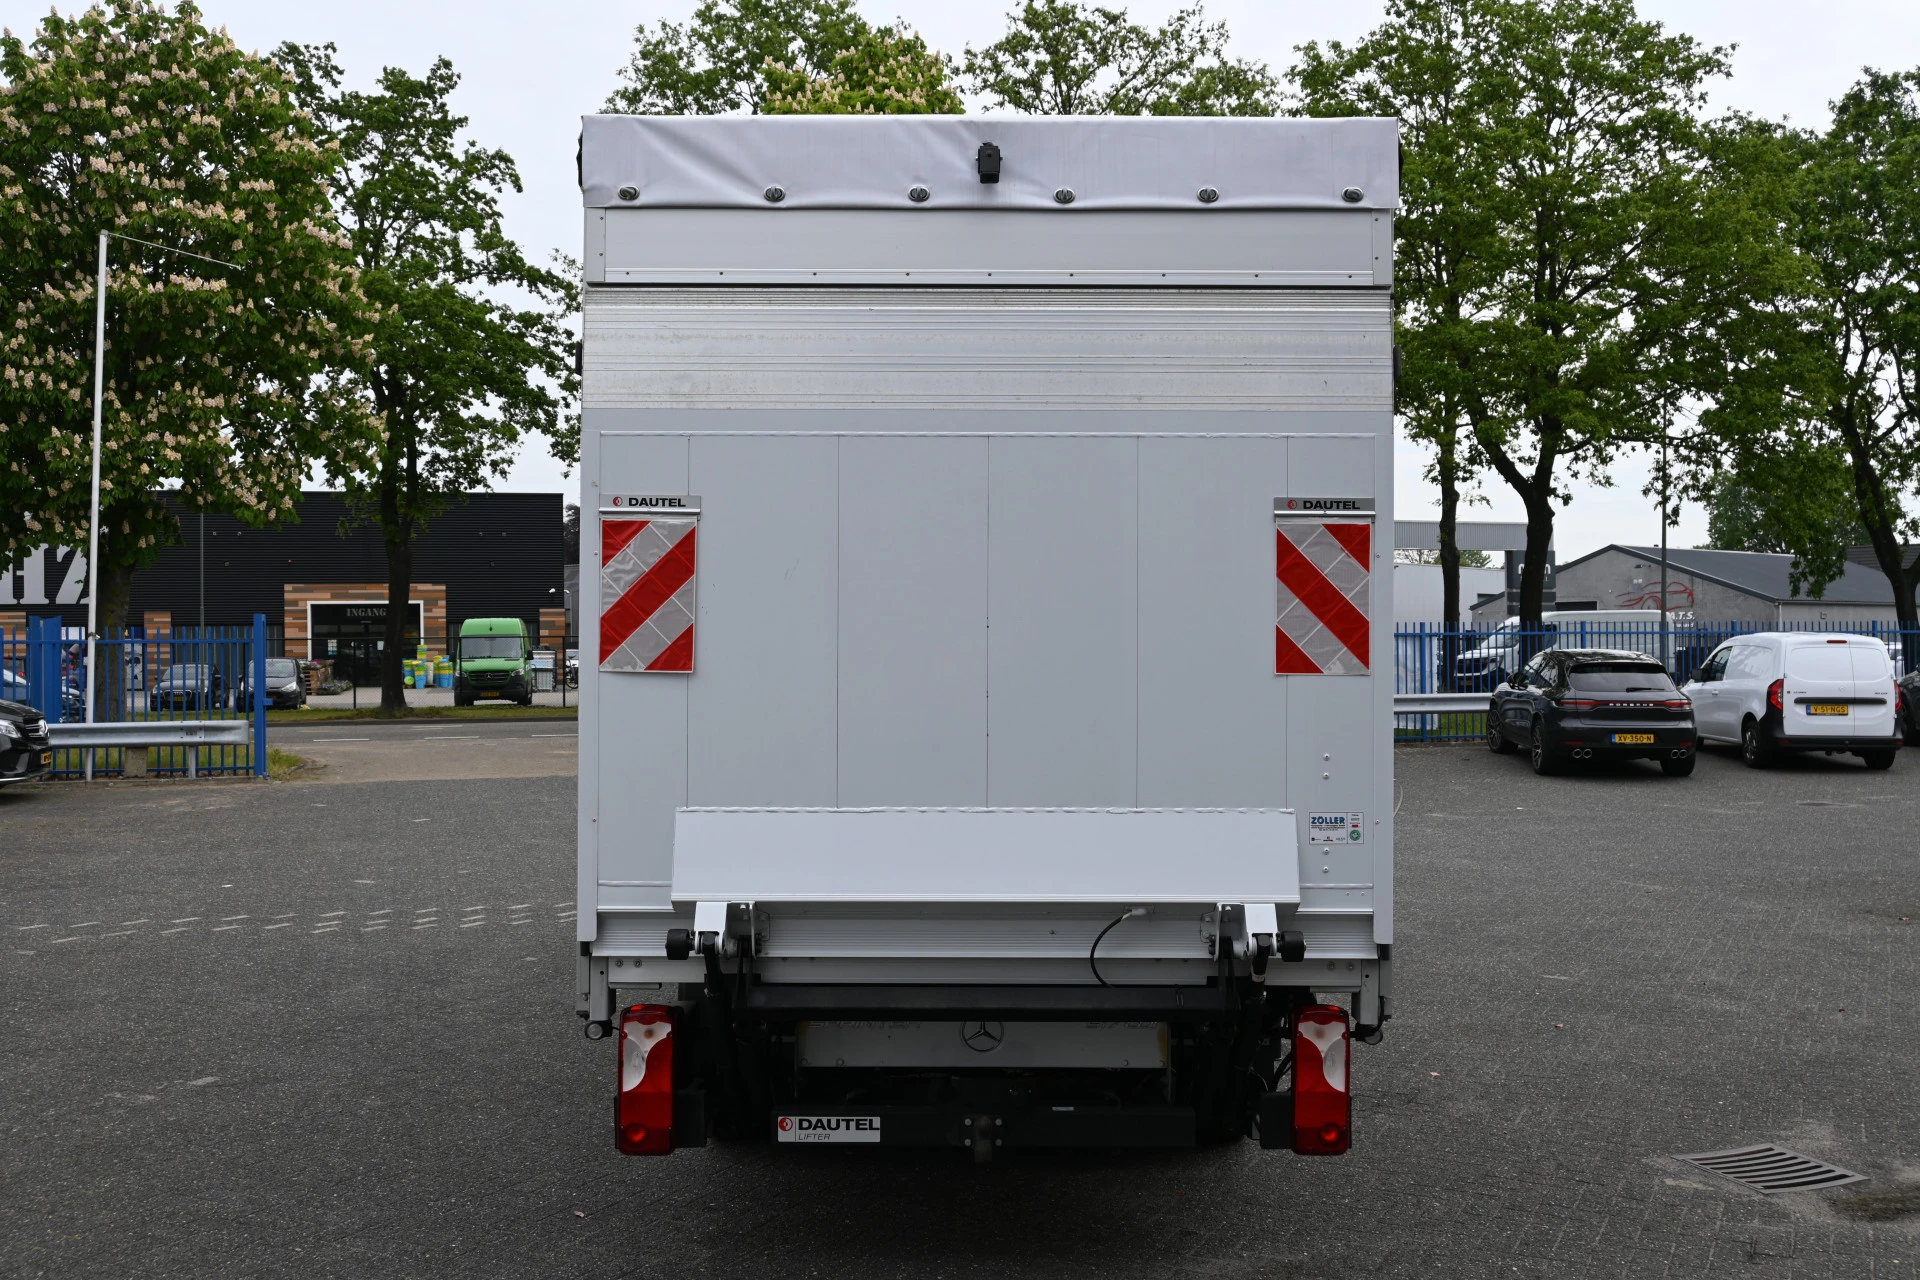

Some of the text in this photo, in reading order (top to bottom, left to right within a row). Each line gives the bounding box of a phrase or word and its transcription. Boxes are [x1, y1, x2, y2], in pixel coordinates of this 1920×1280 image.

[628, 497, 686, 507] DAUTEL
[1303, 500, 1360, 510] DAUTEL
[346, 608, 387, 617] INGANG
[1311, 816, 1345, 824] ZÖLLER
[798, 1118, 880, 1131] DAUTEL
[798, 1133, 831, 1141] LIFTER
